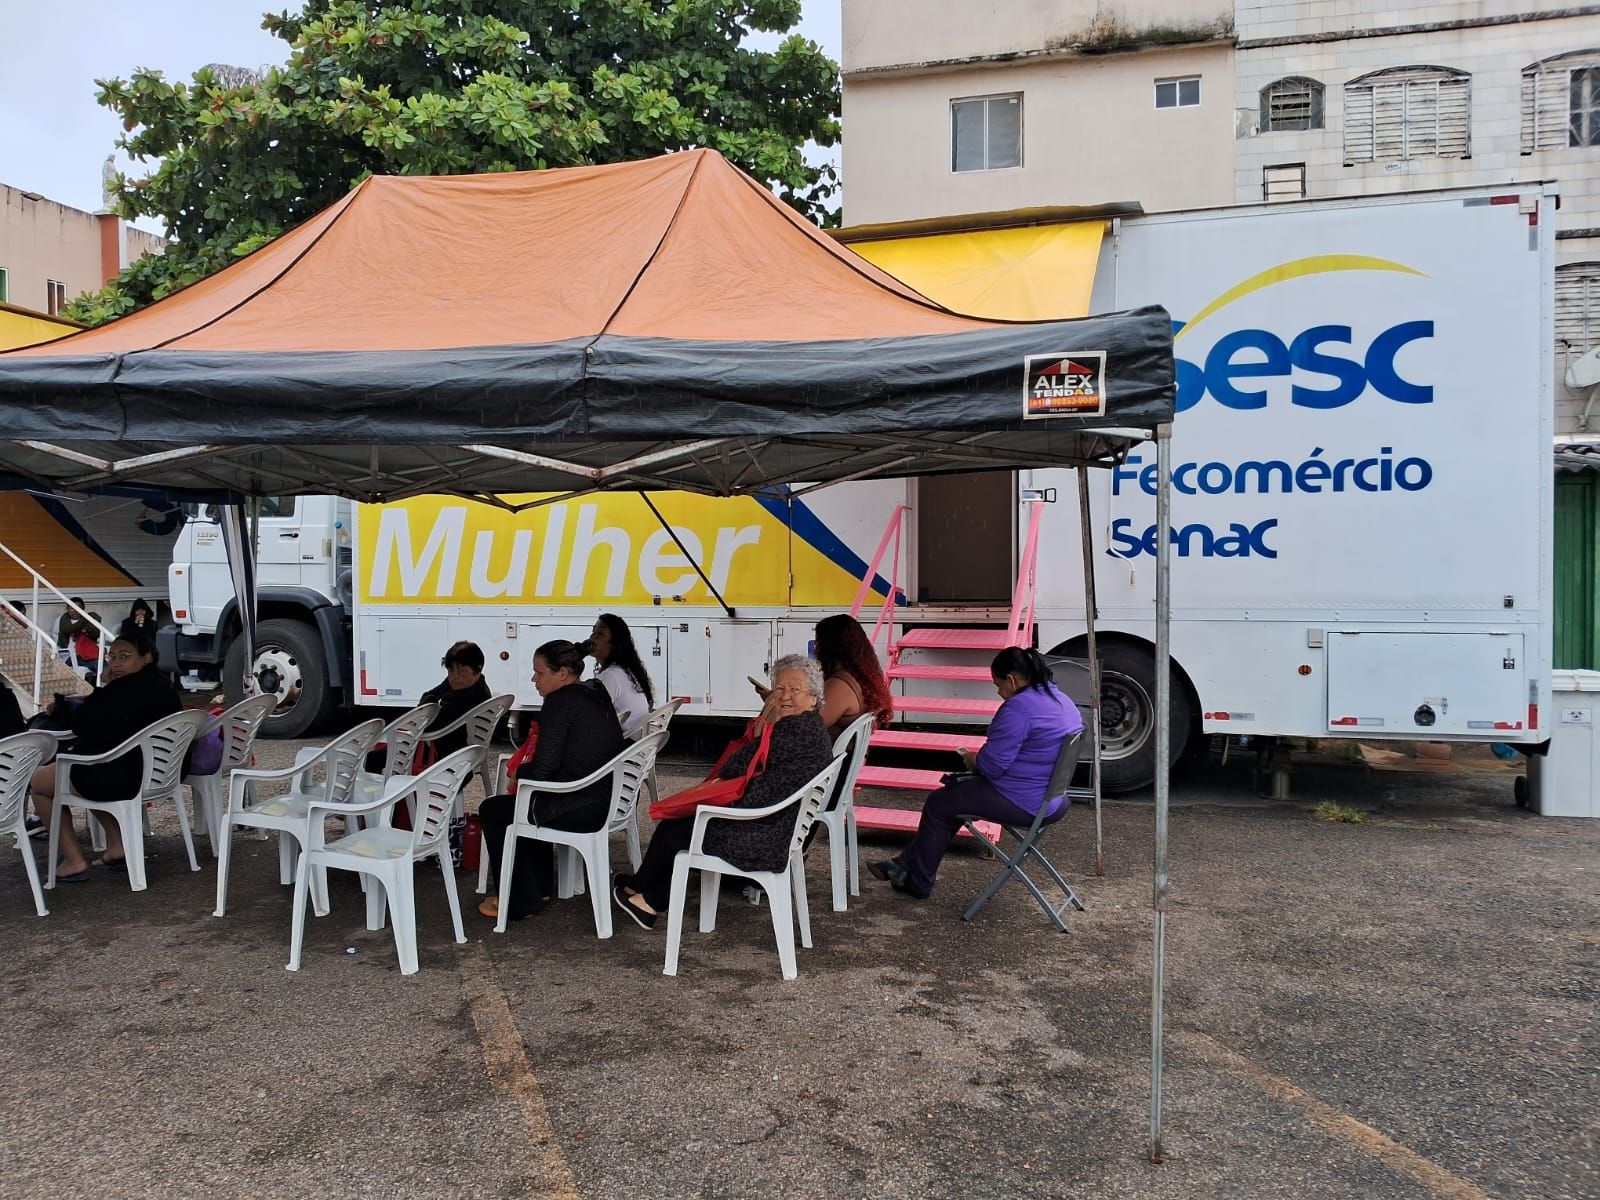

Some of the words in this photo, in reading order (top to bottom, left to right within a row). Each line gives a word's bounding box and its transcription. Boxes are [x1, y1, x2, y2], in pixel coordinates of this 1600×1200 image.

[1033, 388, 1094, 398] TENDAS
[1034, 374, 1093, 389] ALEX
[1112, 447, 1433, 496] Fecomércio
[369, 503, 761, 598] Mulher
[1105, 518, 1278, 559] Senac
